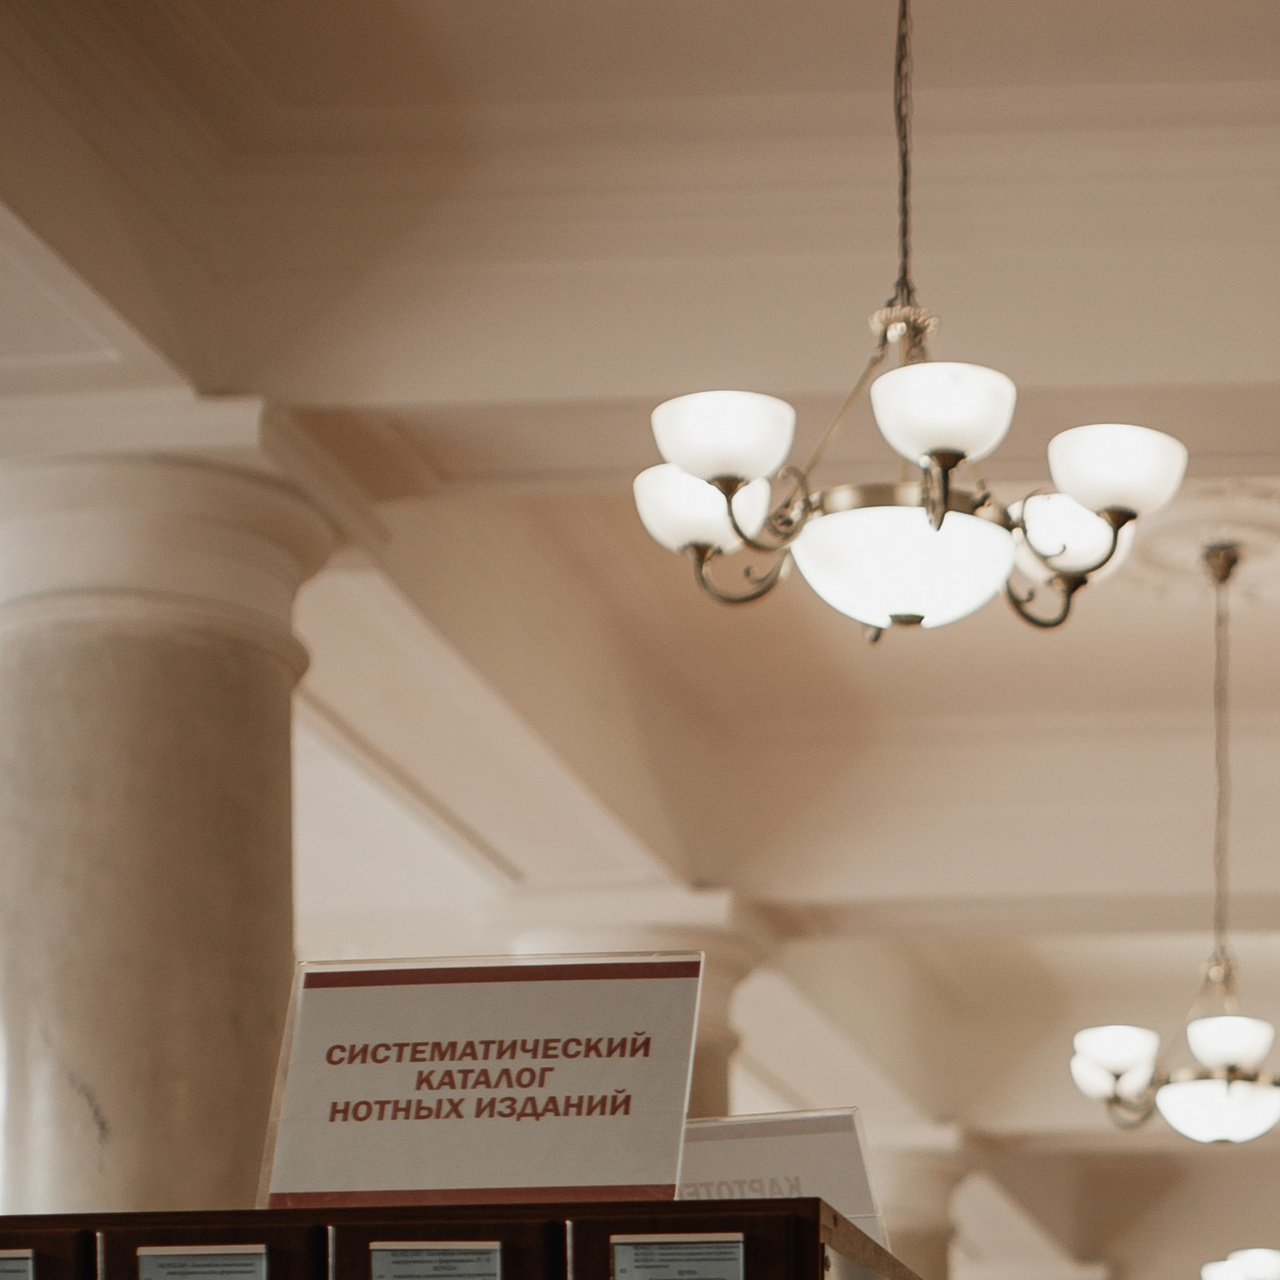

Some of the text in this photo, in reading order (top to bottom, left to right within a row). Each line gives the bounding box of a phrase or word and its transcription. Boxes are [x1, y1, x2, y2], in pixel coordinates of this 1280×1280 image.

[325, 1031, 651, 1065] СИСТЕМАТИЧЕСКИЙ
[415, 1066, 555, 1091] КАТАЛОГ
[328, 1089, 631, 1122] НОТНЫХ ИЗДАНИЙ
